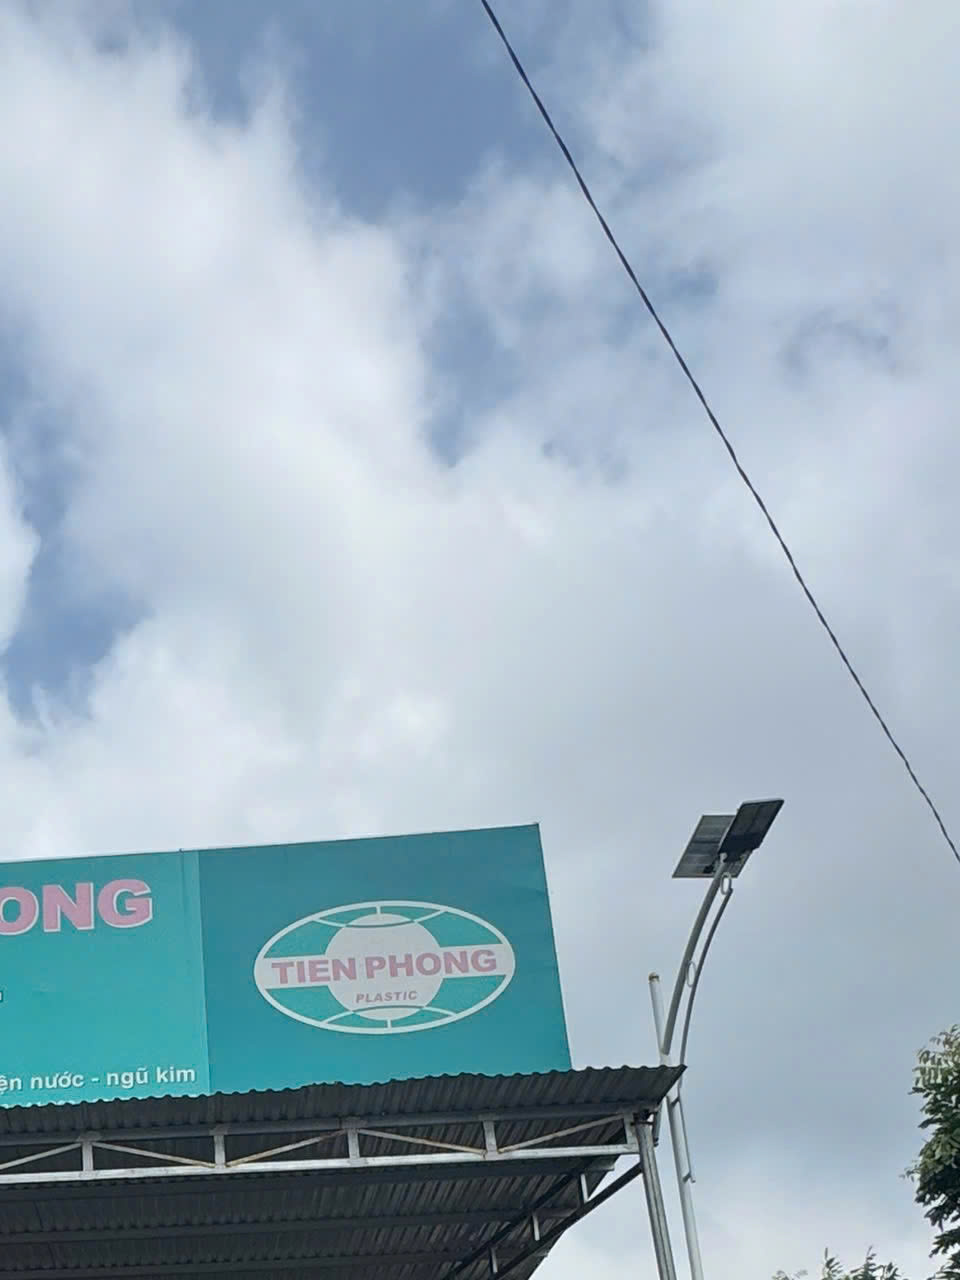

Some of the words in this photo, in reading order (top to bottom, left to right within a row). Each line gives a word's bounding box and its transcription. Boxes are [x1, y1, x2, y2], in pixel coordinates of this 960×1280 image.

[271, 956, 357, 984] TIEN
[364, 949, 498, 979] PHONG
[356, 989, 418, 1004] PLASTIC
[30, 1071, 85, 1090] nước
[106, 1067, 149, 1090] ngũ
[156, 1065, 196, 1084] kim
